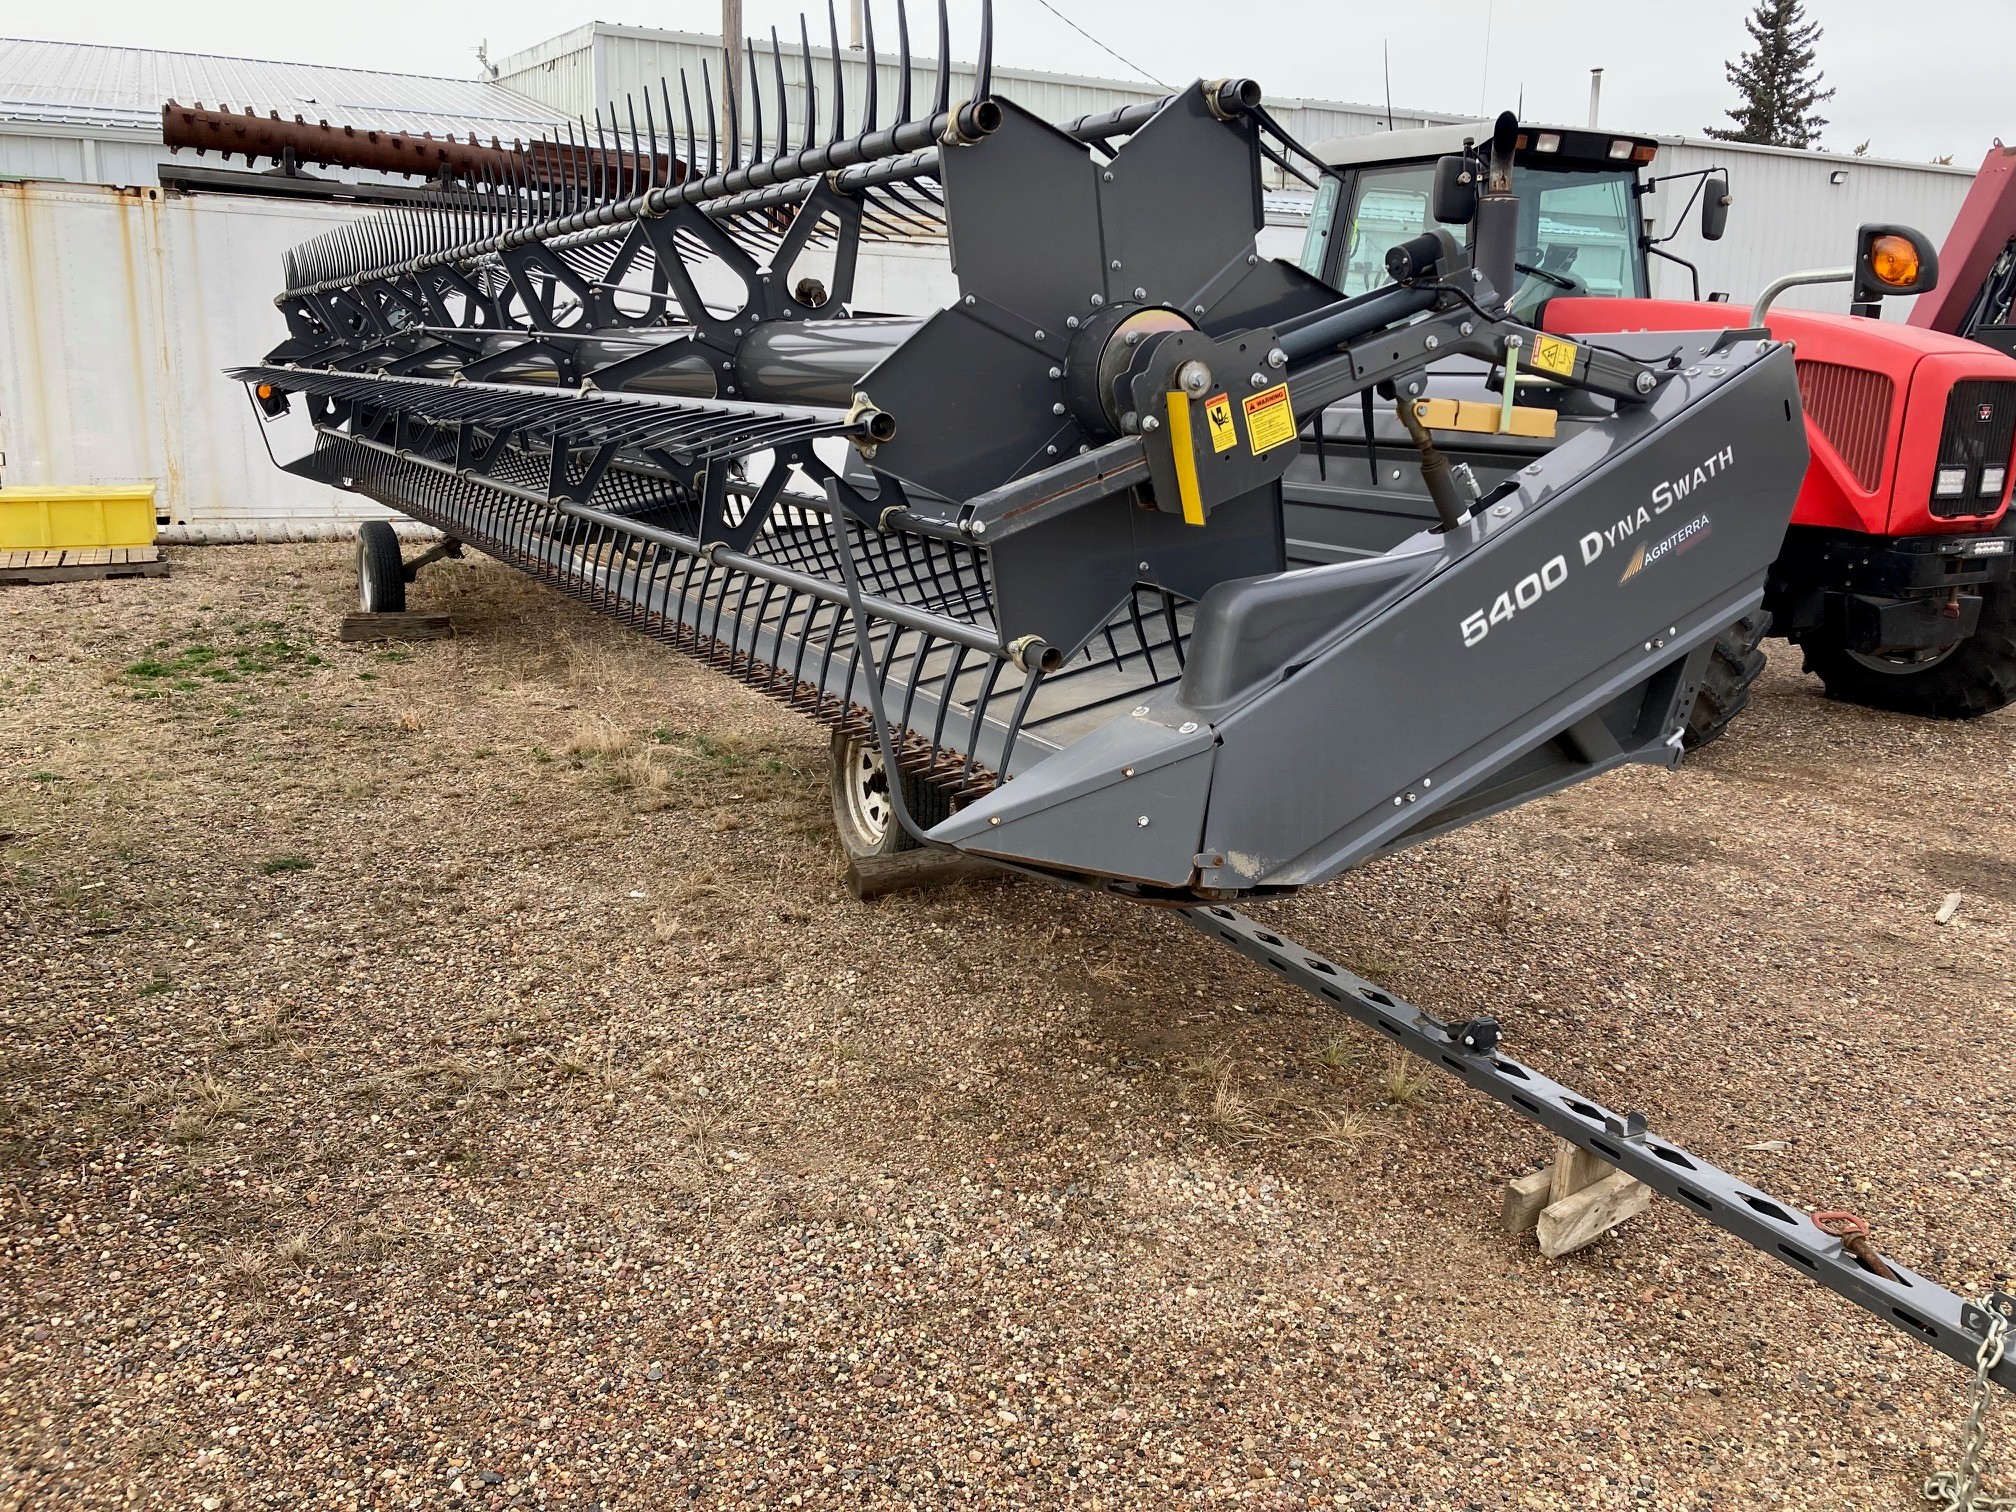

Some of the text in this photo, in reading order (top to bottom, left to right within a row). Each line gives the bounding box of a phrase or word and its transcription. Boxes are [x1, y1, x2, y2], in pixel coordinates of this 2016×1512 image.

[1256, 392, 1284, 407] WARNING
[1644, 514, 1710, 566] AGRITERRA
[1459, 554, 1568, 648] 5400
